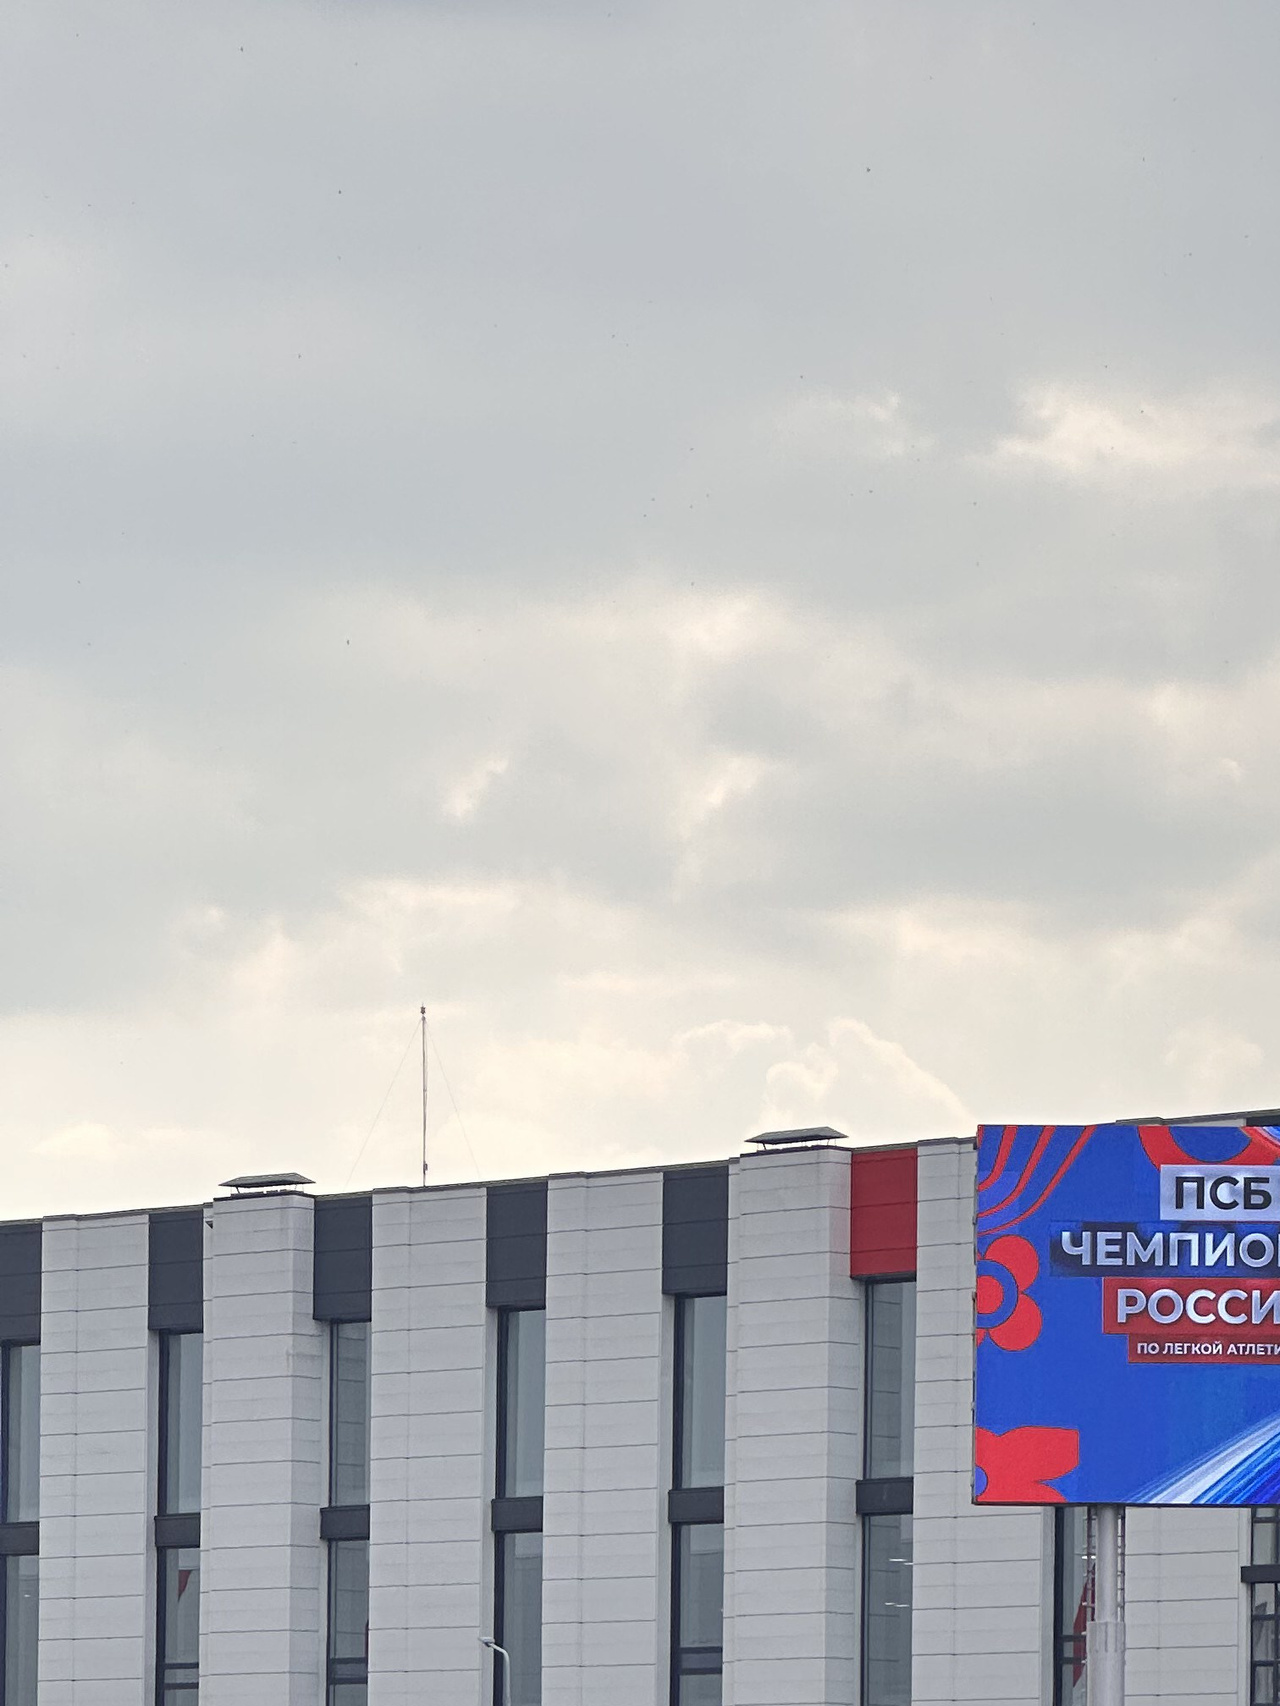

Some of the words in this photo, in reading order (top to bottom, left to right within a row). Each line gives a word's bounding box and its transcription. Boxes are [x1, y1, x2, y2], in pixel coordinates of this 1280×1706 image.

[1175, 1176, 1272, 1210] ПСБ
[1137, 1343, 1159, 1355] ПО
[1163, 1341, 1223, 1355] ЛЕГКОЙ
